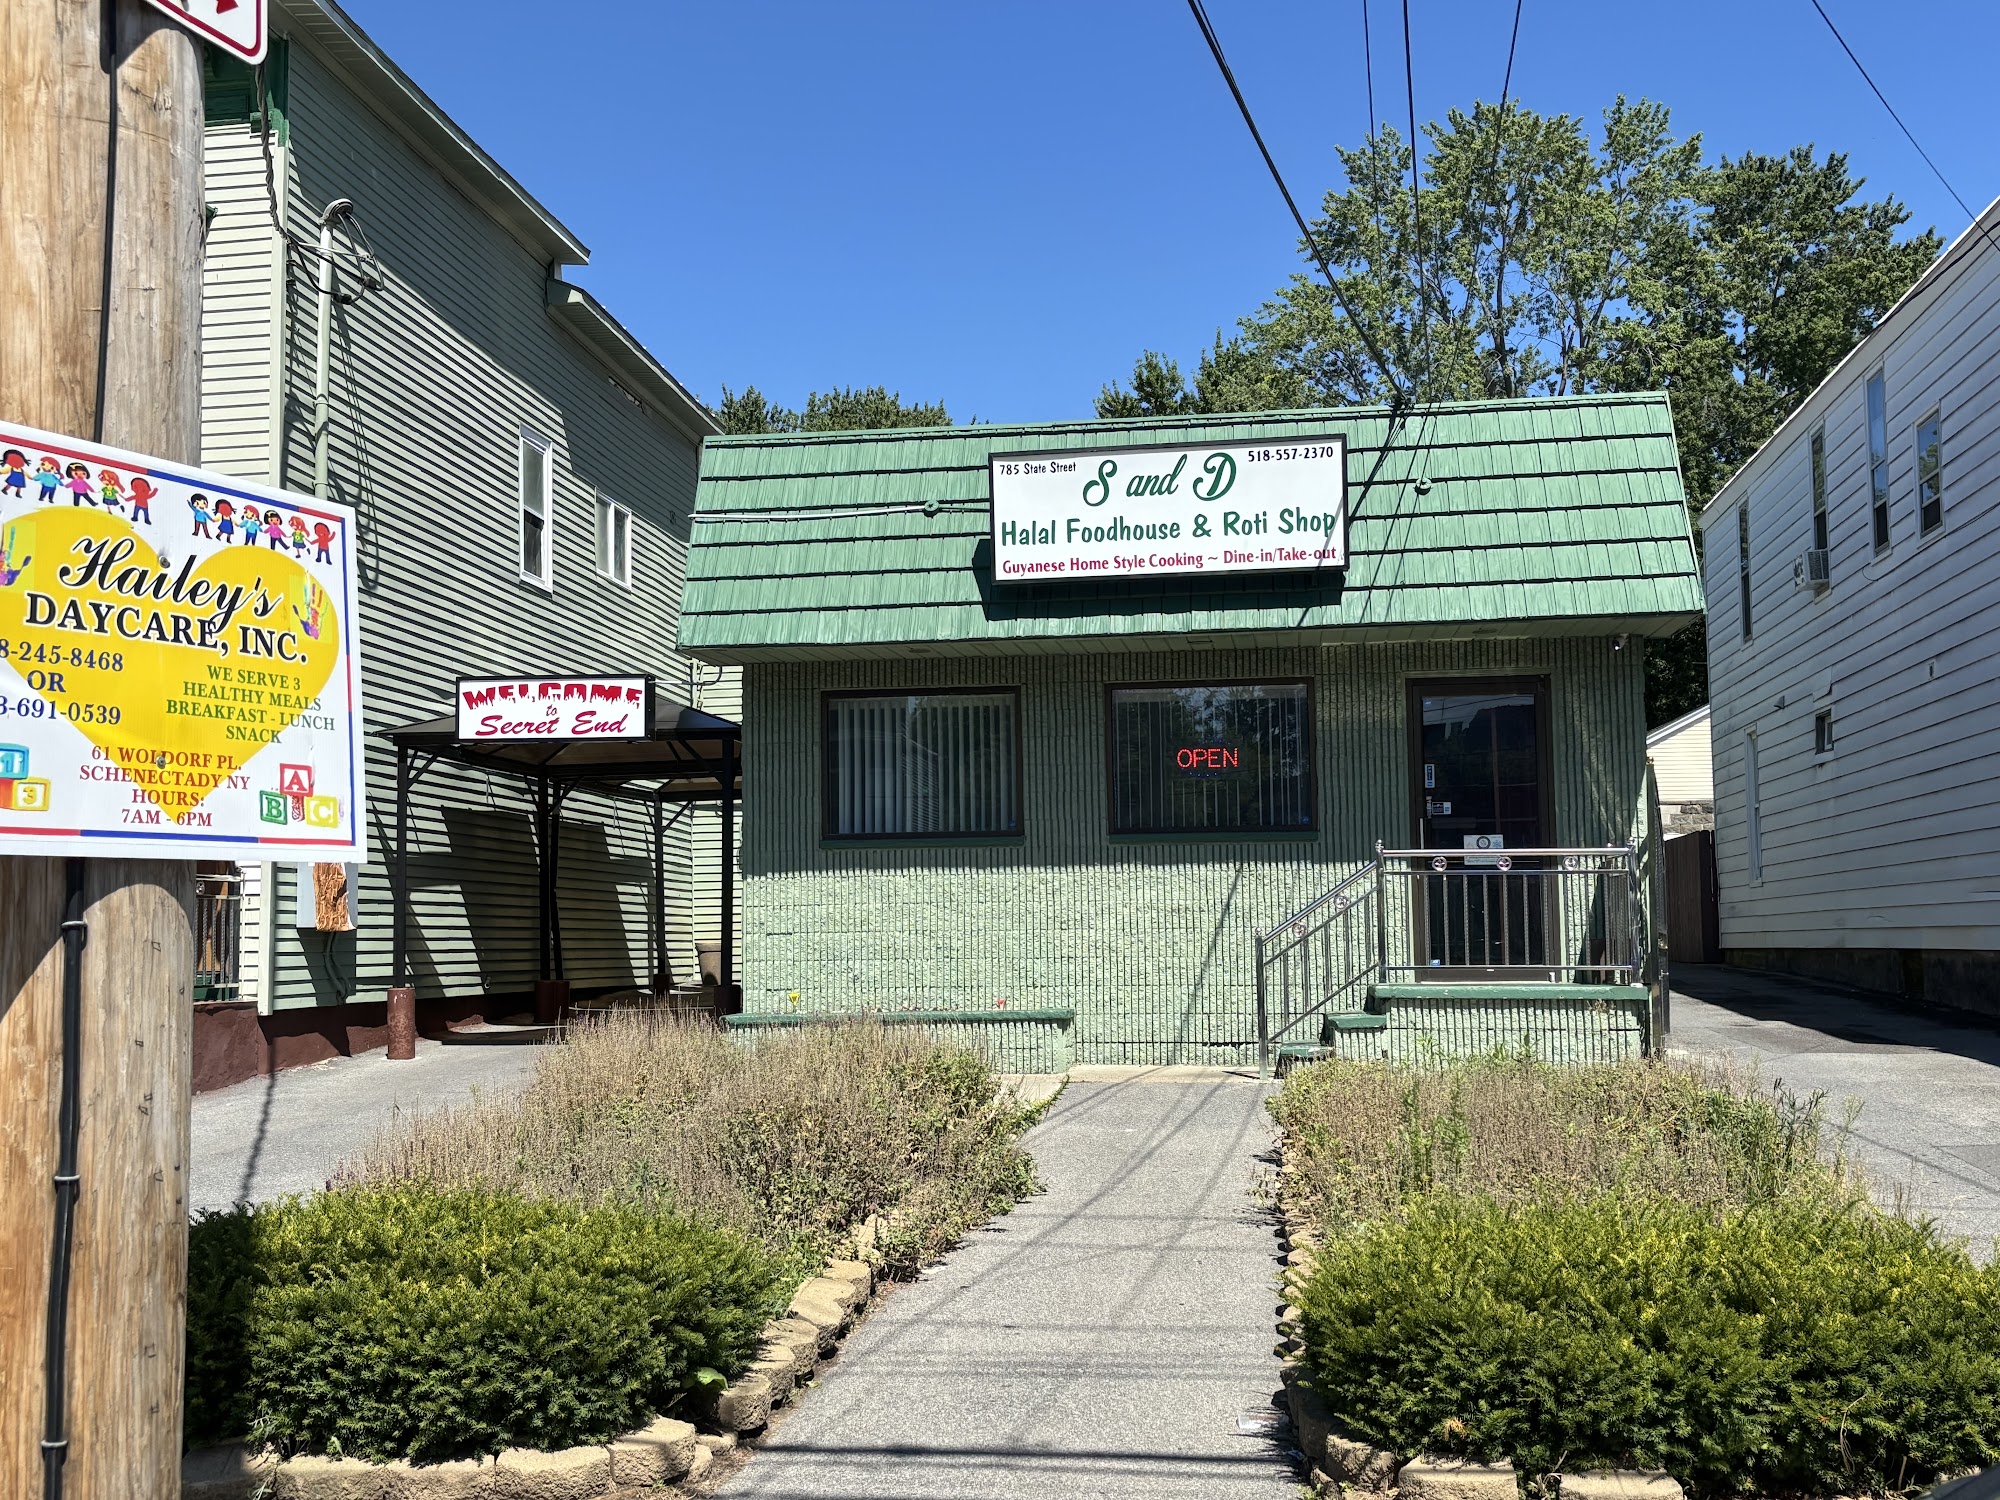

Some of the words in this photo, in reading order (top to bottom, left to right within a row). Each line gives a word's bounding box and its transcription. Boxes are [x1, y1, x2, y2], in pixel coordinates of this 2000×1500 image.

[1248, 446, 1333, 462] 518-557-2370
[1000, 464, 1019, 475] 785
[1023, 462, 1046, 474] State
[1050, 461, 1076, 473] Street
[1082, 459, 1118, 507] S
[1126, 453, 1187, 498] and
[1192, 452, 1237, 501] D
[1001, 519, 1056, 546] Halal
[1066, 515, 1181, 543] Foodhouse
[1192, 513, 1212, 538] &
[1223, 510, 1268, 536] Roti
[1278, 506, 1335, 538] Shop
[1002, 560, 1066, 577] Guyanese
[1070, 557, 1109, 571] Home
[1113, 554, 1145, 572] Style
[1149, 552, 1204, 569] Cooking
[1223, 546, 1337, 564] Dine-in/Take-out
[59, 537, 283, 635] Hailey's
[26, 592, 230, 658] DAYCARE,
[239, 625, 308, 664] INC.
[0, 638, 124, 672] 8-245-8468
[27, 670, 66, 693] OR
[206, 665, 233, 681] WE
[237, 669, 290, 689] SERVE
[293, 677, 301, 691] 3
[183, 681, 265, 705] HEALTHY
[269, 692, 321, 712] MEALS
[462, 682, 643, 711] WELCOME
[166, 699, 268, 723] BREAKFAST
[279, 712, 335, 731] LUNCH
[545, 703, 558, 717] to
[226, 725, 282, 744] SNACK
[475, 714, 560, 737] Secret
[571, 710, 629, 736] End
[91, 745, 110, 761] 61
[217, 755, 242, 771] PL.
[1176, 747, 1238, 768] OPEN
[79, 765, 222, 788] SCHENECTADY
[226, 775, 251, 790] NY
[284, 770, 308, 791] A
[23, 785, 37, 805] 3
[131, 788, 205, 807] HOURS:
[265, 796, 283, 818] B
[121, 808, 161, 825] 7AM
[176, 811, 213, 827] 6PM
[312, 801, 334, 824] C
